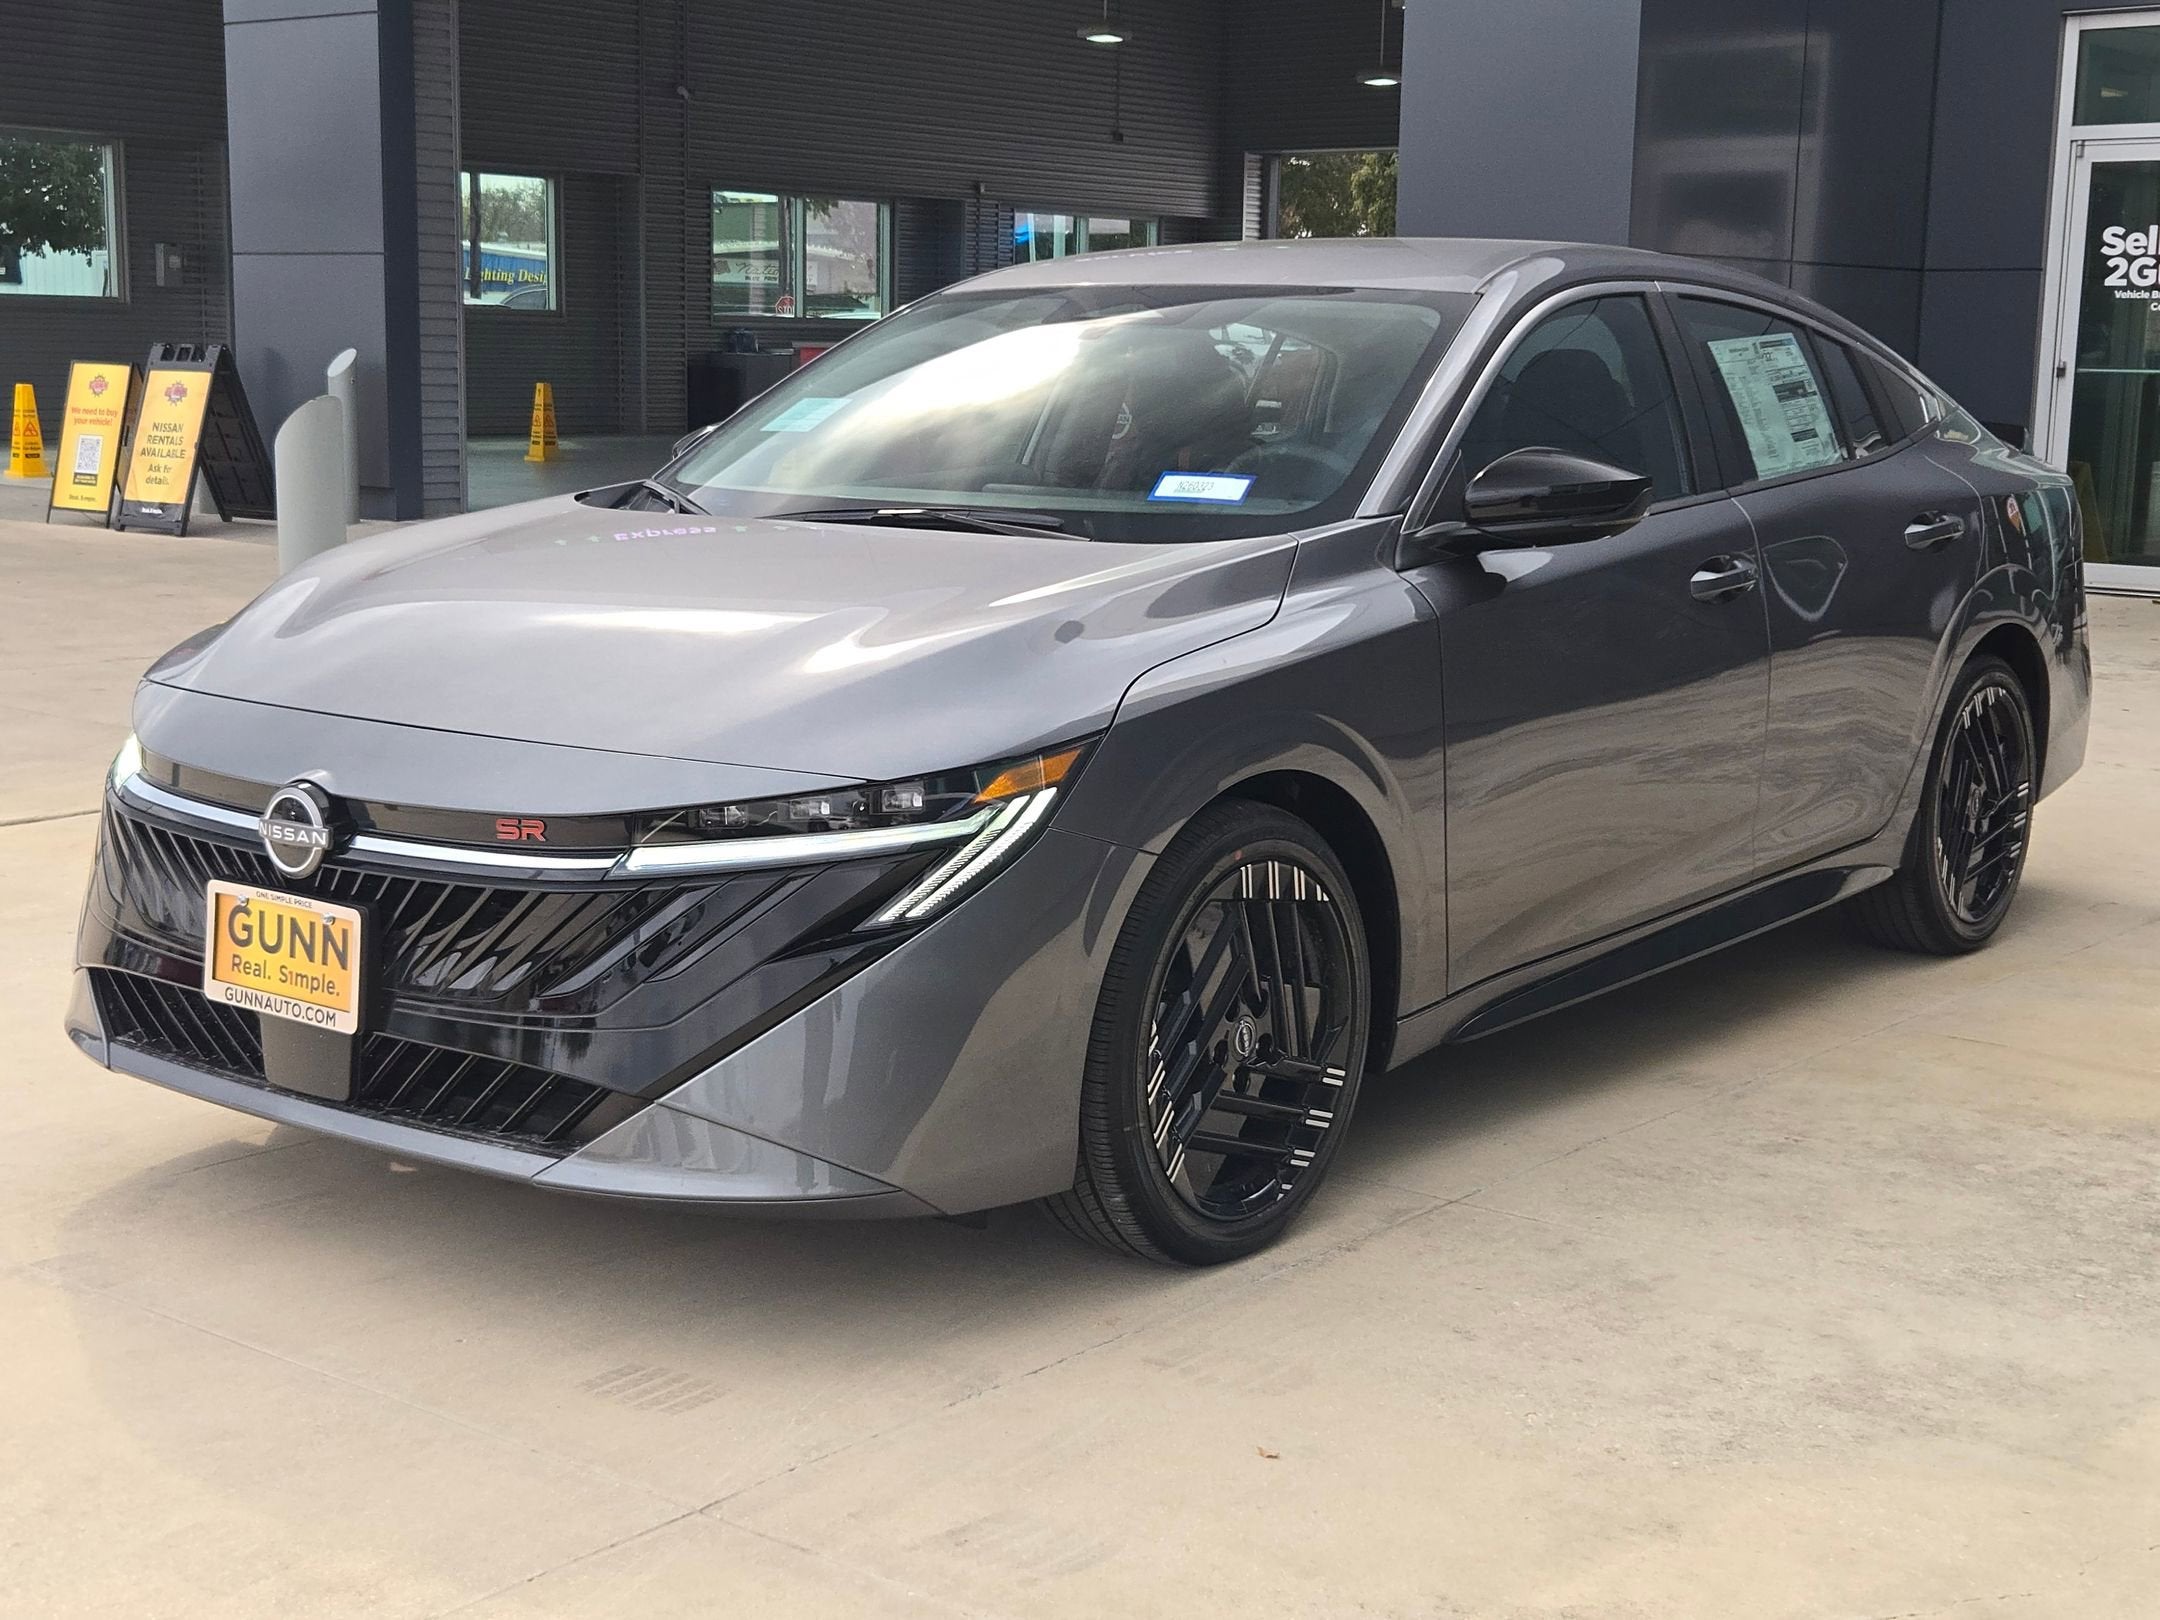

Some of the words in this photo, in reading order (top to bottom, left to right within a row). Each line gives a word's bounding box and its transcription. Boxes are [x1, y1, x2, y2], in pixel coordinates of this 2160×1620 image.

[2101, 225, 2160, 256] Sel
[2104, 257, 2160, 287] 2G
[2114, 289, 2150, 299] Vehicle
[2151, 290, 2160, 299] B
[2150, 302, 2160, 311] C
[82, 407, 97, 415] need
[98, 408, 105, 416] to
[106, 408, 118, 418] buy
[73, 417, 87, 426] your
[152, 421, 184, 433] NISSAN
[147, 434, 184, 446] RENTALS
[140, 447, 187, 459] AVAILABLE
[148, 463, 161, 473] Ask
[259, 822, 328, 846] NISSAN
[495, 818, 546, 842] SR
[256, 890, 270, 900] ONE
[271, 893, 293, 905] SIMPLE
[294, 898, 313, 909] PRICE
[228, 904, 349, 972] GUNN
[231, 953, 272, 980] Real.
[224, 987, 337, 1027] GUNNAUTO.COM
